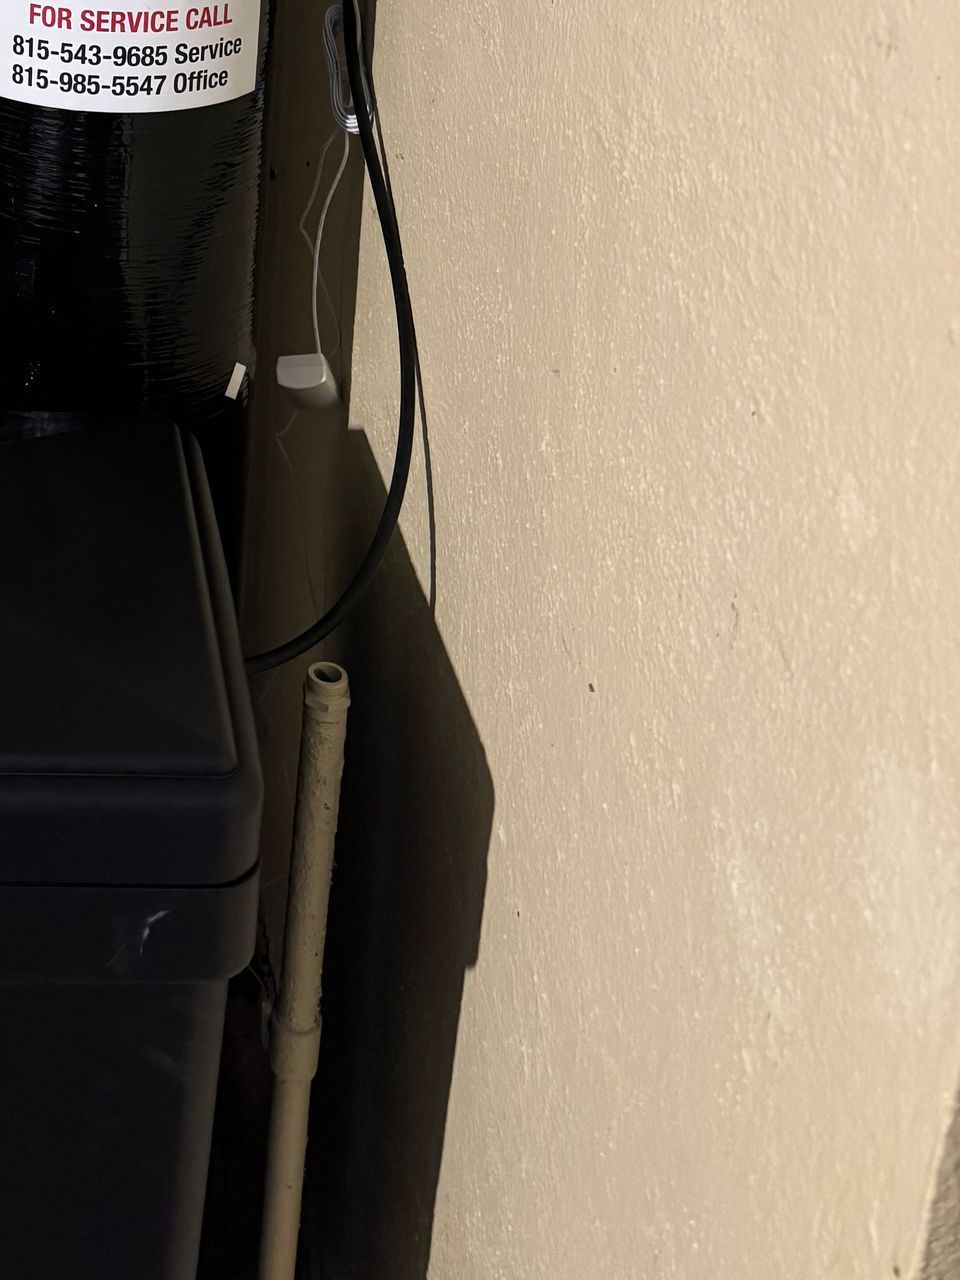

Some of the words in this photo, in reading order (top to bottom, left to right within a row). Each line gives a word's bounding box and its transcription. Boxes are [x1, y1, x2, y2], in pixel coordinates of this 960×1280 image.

[29, 3, 72, 29] FOR
[80, 9, 179, 32] SERVICE
[186, 4, 232, 29] CALL
[12, 35, 167, 66] 815-543-9685
[175, 37, 242, 64] Service
[12, 64, 166, 96] 815-985-5547
[174, 70, 228, 93] Office
